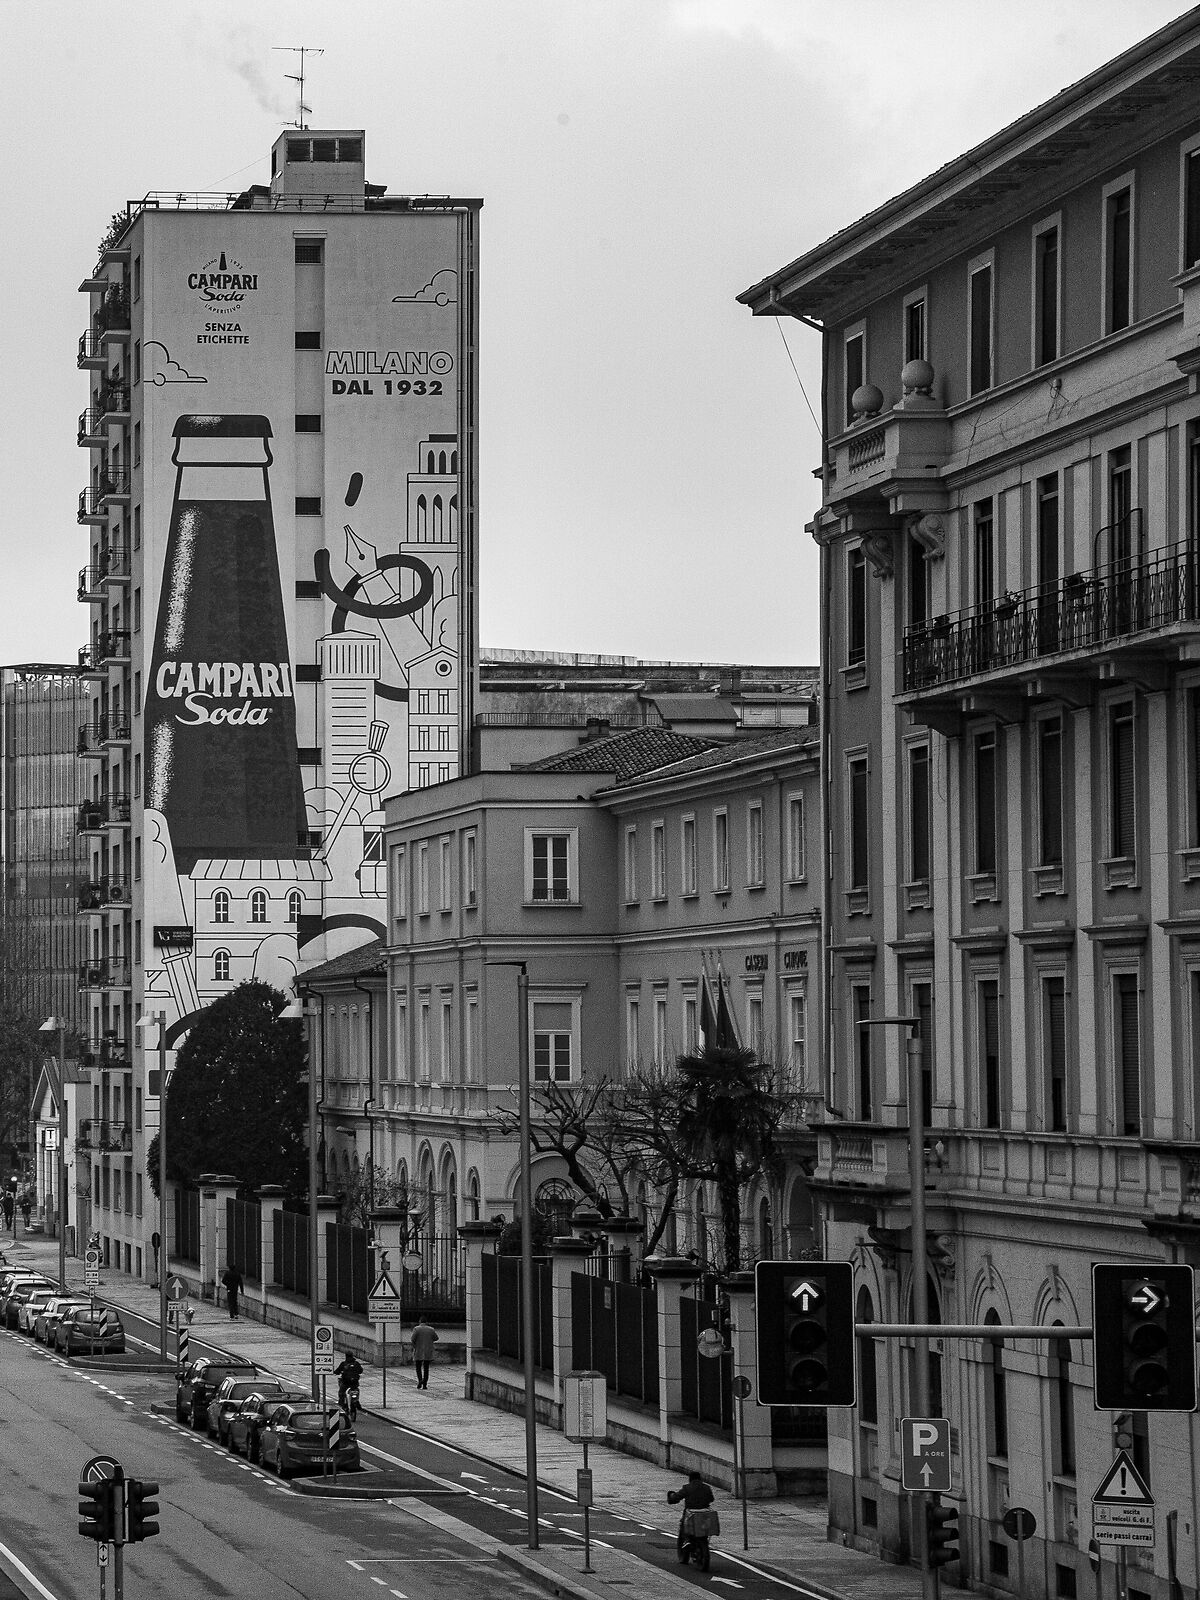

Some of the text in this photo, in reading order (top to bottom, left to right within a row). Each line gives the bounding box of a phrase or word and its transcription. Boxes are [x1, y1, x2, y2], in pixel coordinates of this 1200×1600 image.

[187, 273, 258, 290] CAMPARI
[199, 286, 246, 302] Soda
[204, 322, 242, 332] SENZA
[196, 334, 250, 344] ETICHETTE
[325, 351, 454, 375] MILANO
[332, 380, 443, 396] DAL 1932
[156, 661, 293, 698] CAMPARI
[174, 692, 269, 726] Soda
[912, 1423, 939, 1457] P
